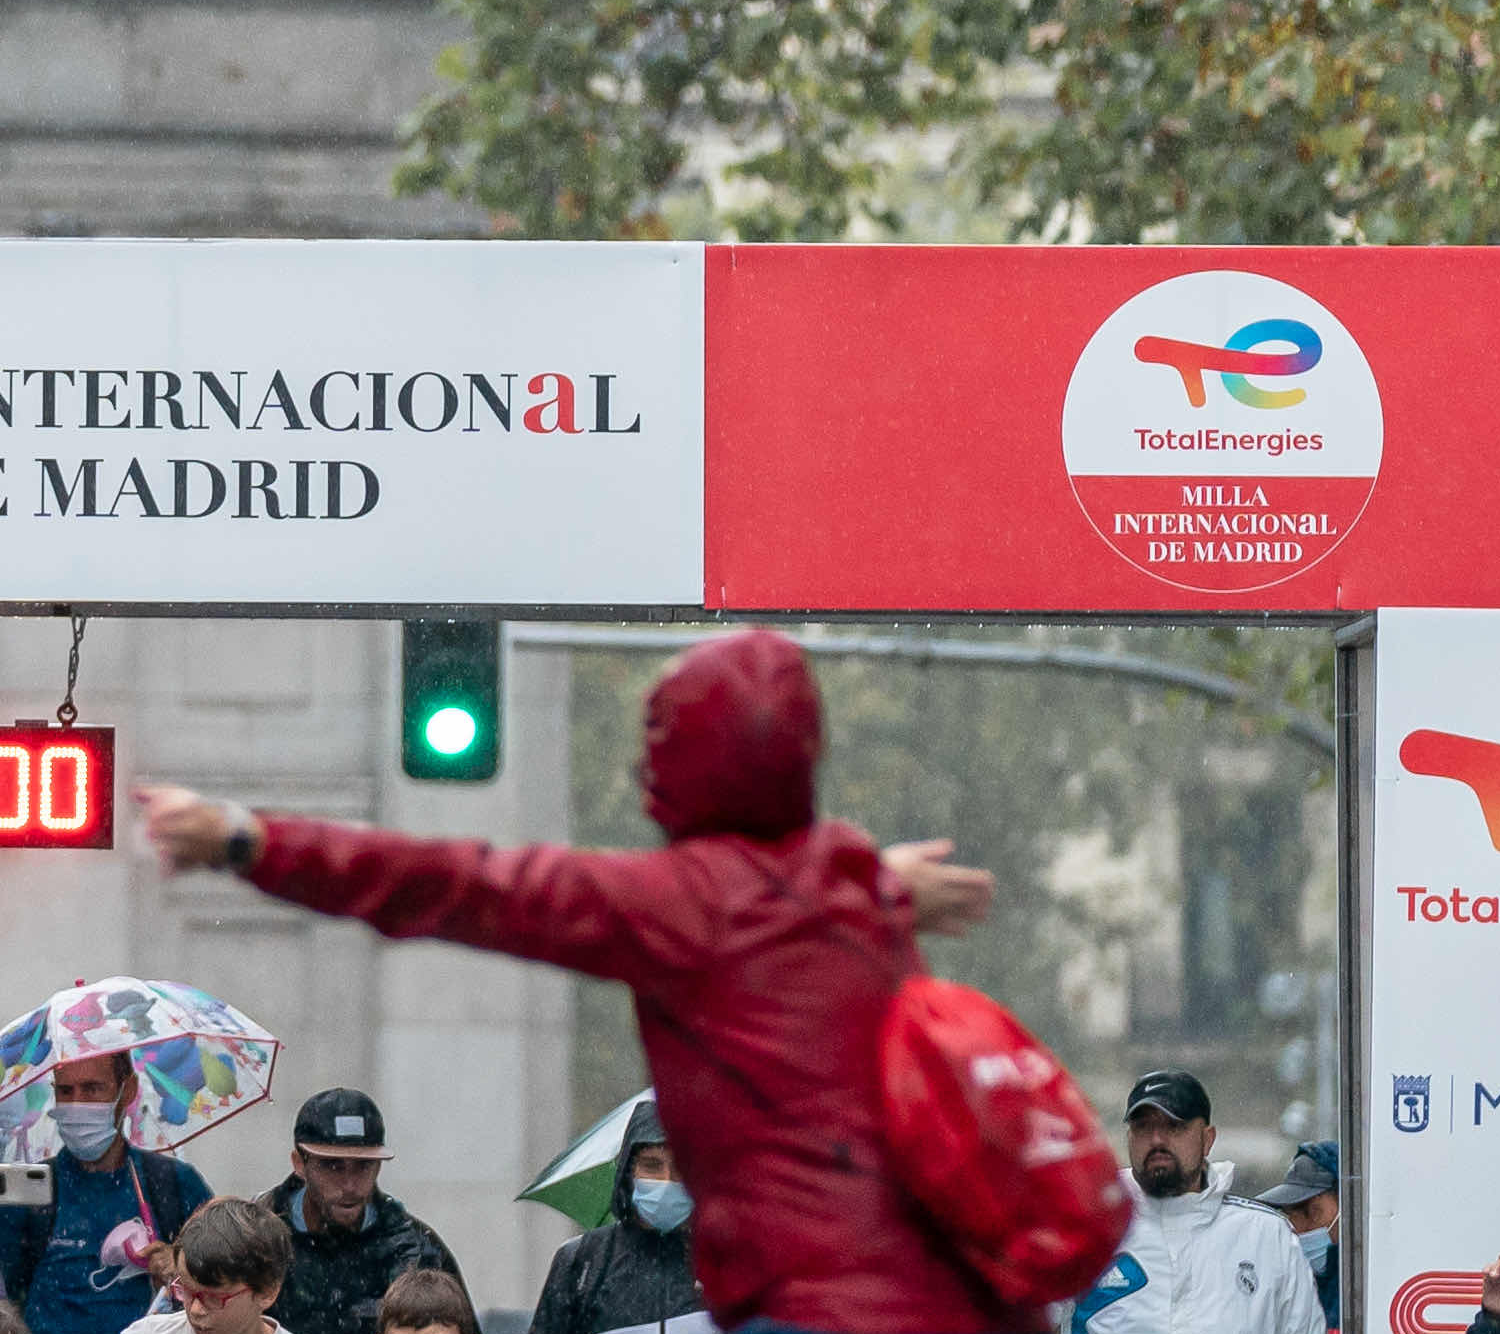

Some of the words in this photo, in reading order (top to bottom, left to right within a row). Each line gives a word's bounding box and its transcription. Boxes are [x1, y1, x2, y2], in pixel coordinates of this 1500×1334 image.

[1135, 428, 1323, 457] TotalEnergies
[34, 457, 380, 520] MADRID
[1182, 485, 1270, 507] MILLA
[1148, 541, 1186, 562] DE
[1193, 541, 1303, 563] MADRID
